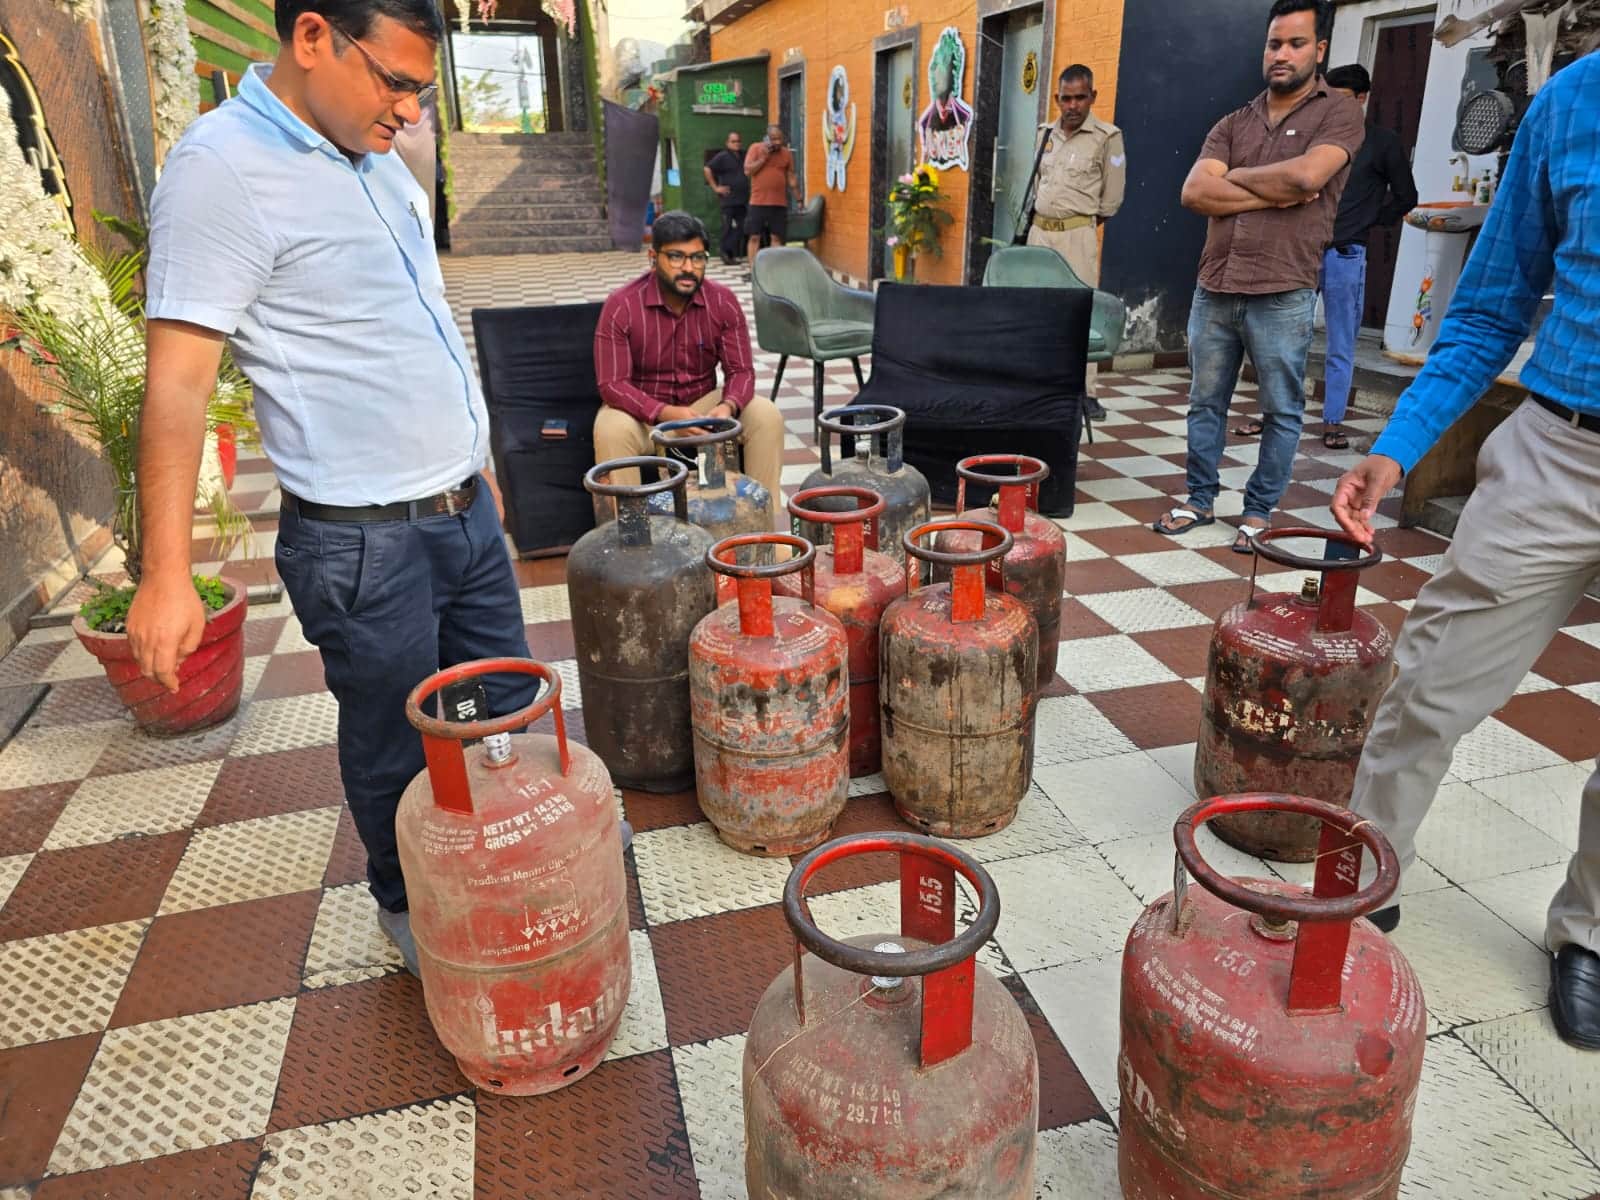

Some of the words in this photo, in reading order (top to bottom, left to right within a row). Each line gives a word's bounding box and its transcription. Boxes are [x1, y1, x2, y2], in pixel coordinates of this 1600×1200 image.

[483, 820, 512, 838] NETT
[484, 829, 522, 850] GROSS
[919, 875, 943, 914] 15.5
[846, 1103, 879, 1125] 29.7
